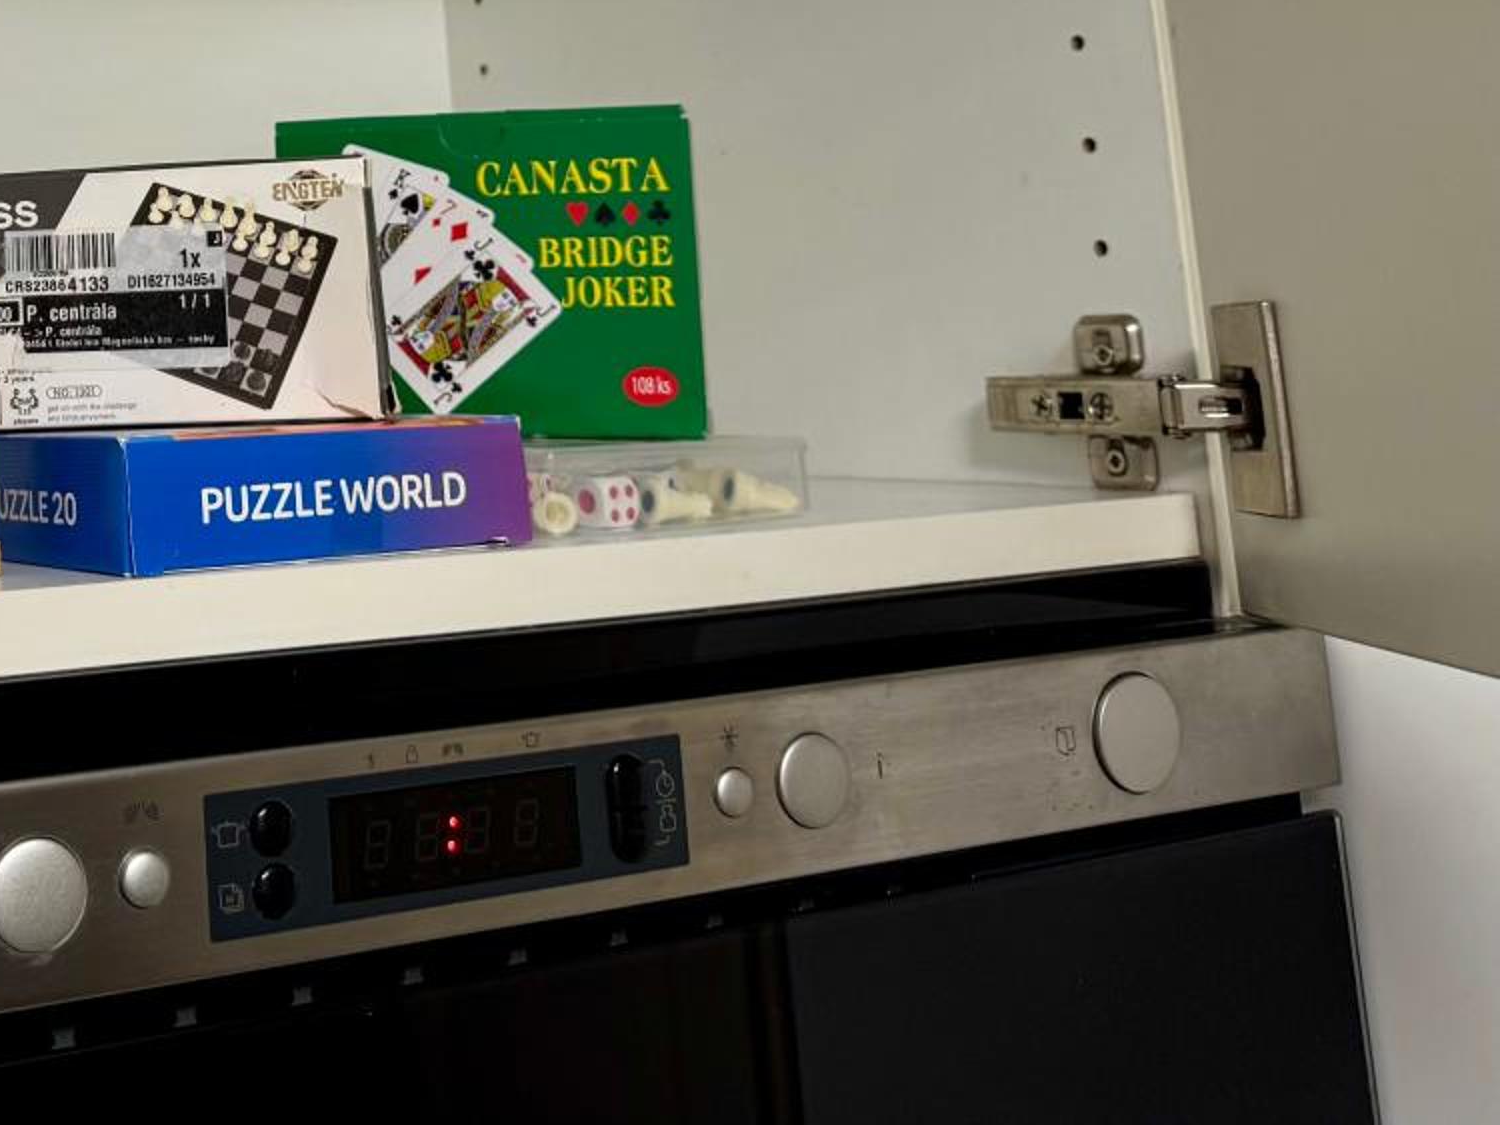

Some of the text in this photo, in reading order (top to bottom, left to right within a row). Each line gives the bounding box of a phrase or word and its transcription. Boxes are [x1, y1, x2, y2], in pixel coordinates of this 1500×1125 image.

[475, 157, 671, 198] CANASTA
[180, 248, 201, 268] 1x
[538, 235, 673, 269] BRIDGE
[560, 276, 675, 310] JOKER
[26, 305, 44, 322] P.
[632, 376, 672, 395] 108 ks
[52, 491, 77, 527] 20
[201, 471, 467, 524] PUZZLE WORLD
